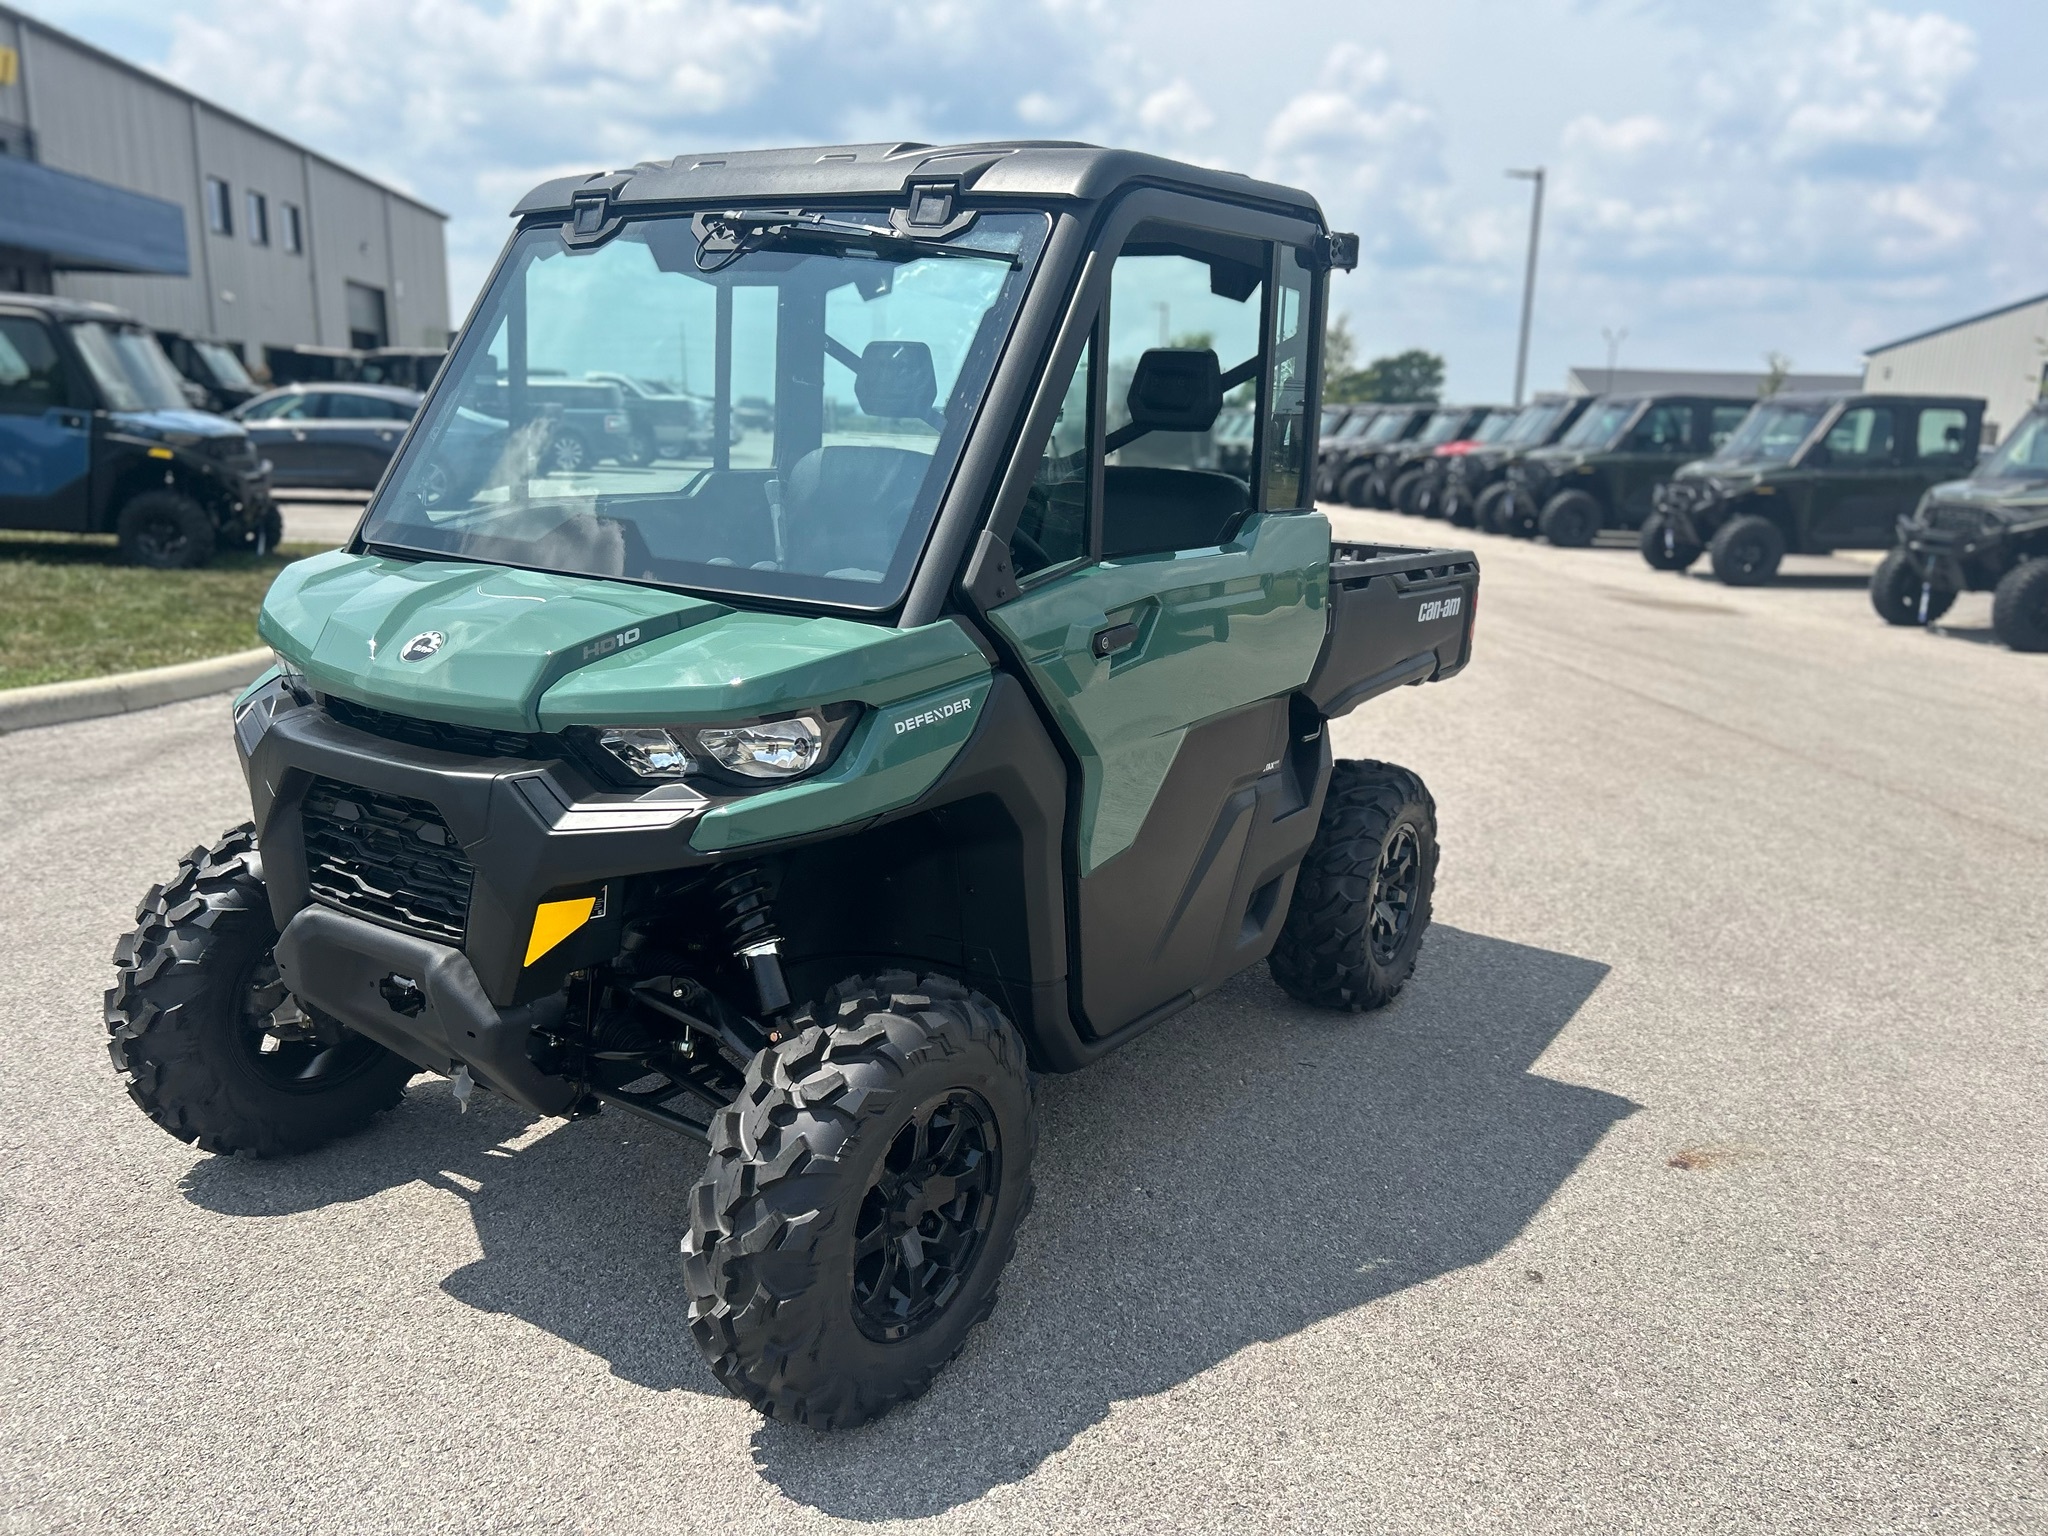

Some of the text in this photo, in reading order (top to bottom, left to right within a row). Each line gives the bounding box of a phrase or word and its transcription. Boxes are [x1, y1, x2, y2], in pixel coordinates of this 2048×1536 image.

[1418, 597, 1461, 622] can-am
[583, 628, 640, 660] HD10
[894, 698, 972, 735] DEFENDER
